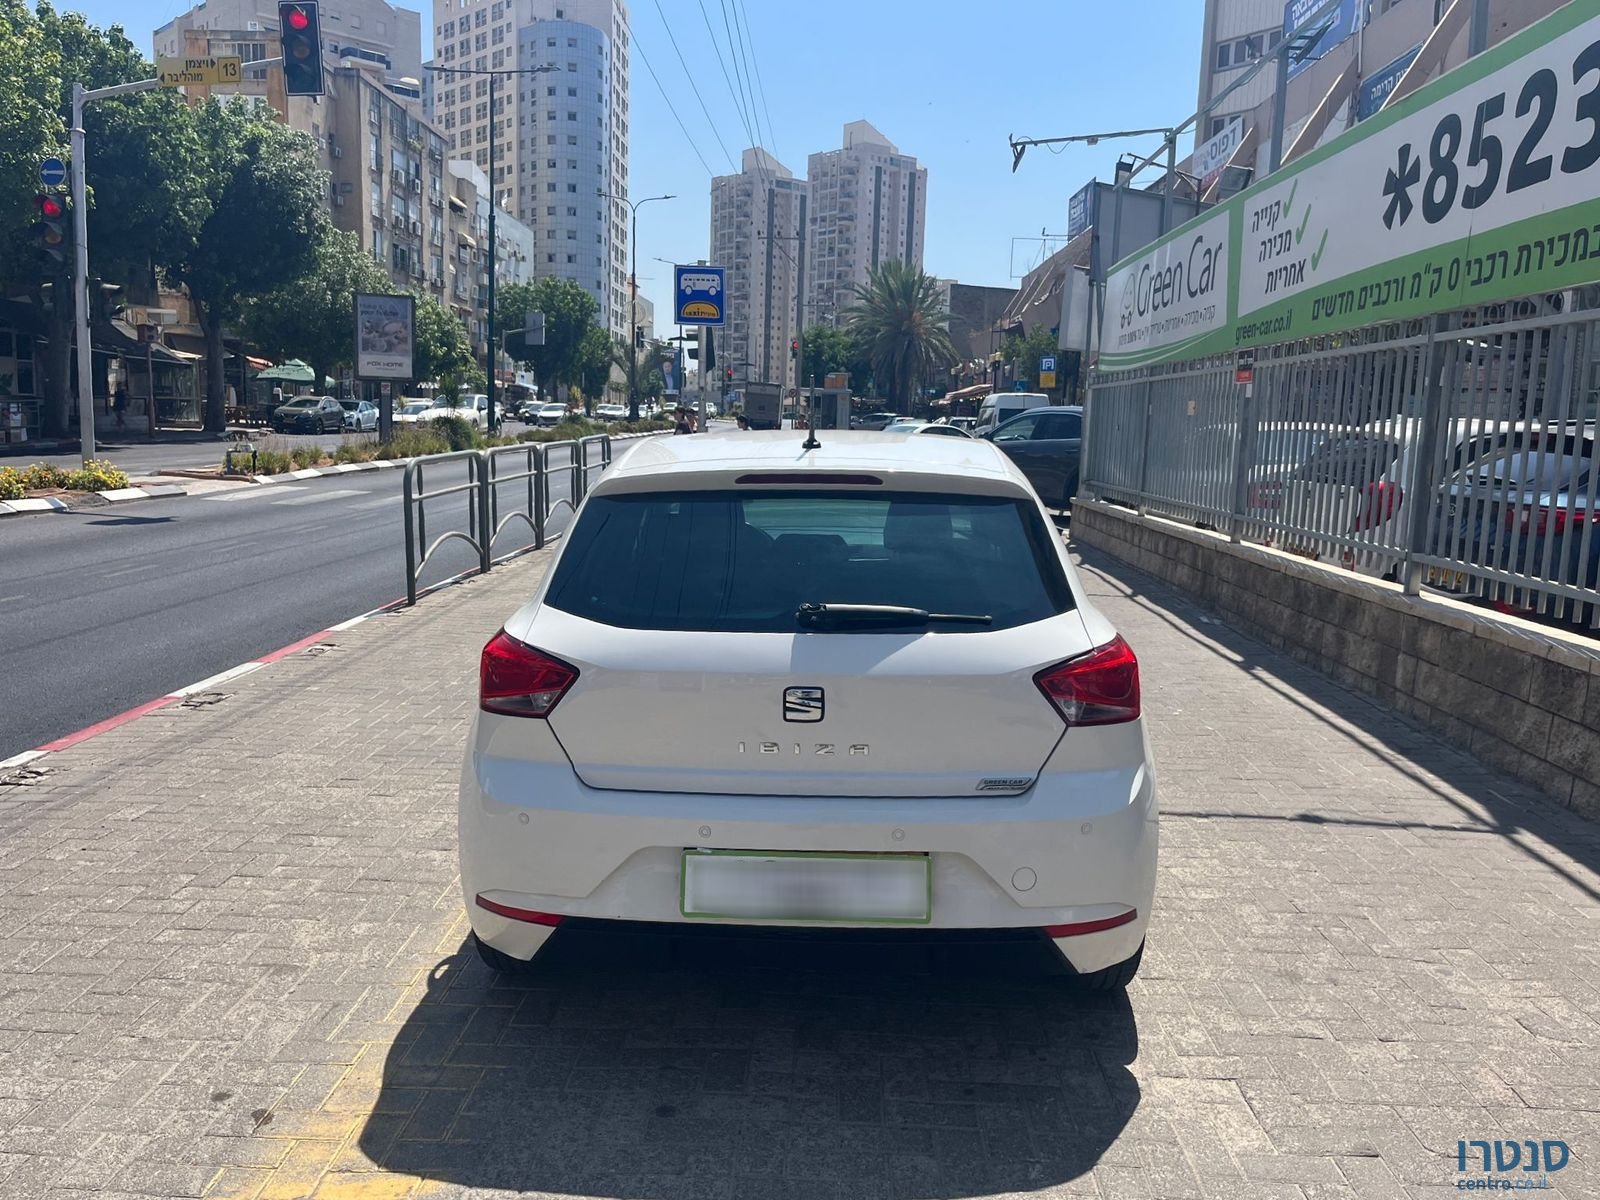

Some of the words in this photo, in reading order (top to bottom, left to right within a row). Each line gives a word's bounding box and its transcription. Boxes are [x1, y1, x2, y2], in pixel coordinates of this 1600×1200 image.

[167, 70, 203, 82] מוהליבר
[185, 59, 209, 71] ויצמן
[222, 63, 237, 77] 13
[1210, 126, 1237, 160] דפוס
[1252, 200, 1281, 232] קנייה
[1259, 229, 1292, 262] מכירה
[1137, 261, 1183, 317] Green
[1187, 235, 1223, 298] Car
[1265, 258, 1307, 294] אחריות
[1447, 257, 1461, 291] 0
[1465, 250, 1509, 287] רכבי
[1311, 289, 1355, 321] חדשים
[1357, 276, 1406, 311] ורכבים
[1235, 309, 1293, 345] green-car.co.il
[737, 741, 870, 756] IBIZA
